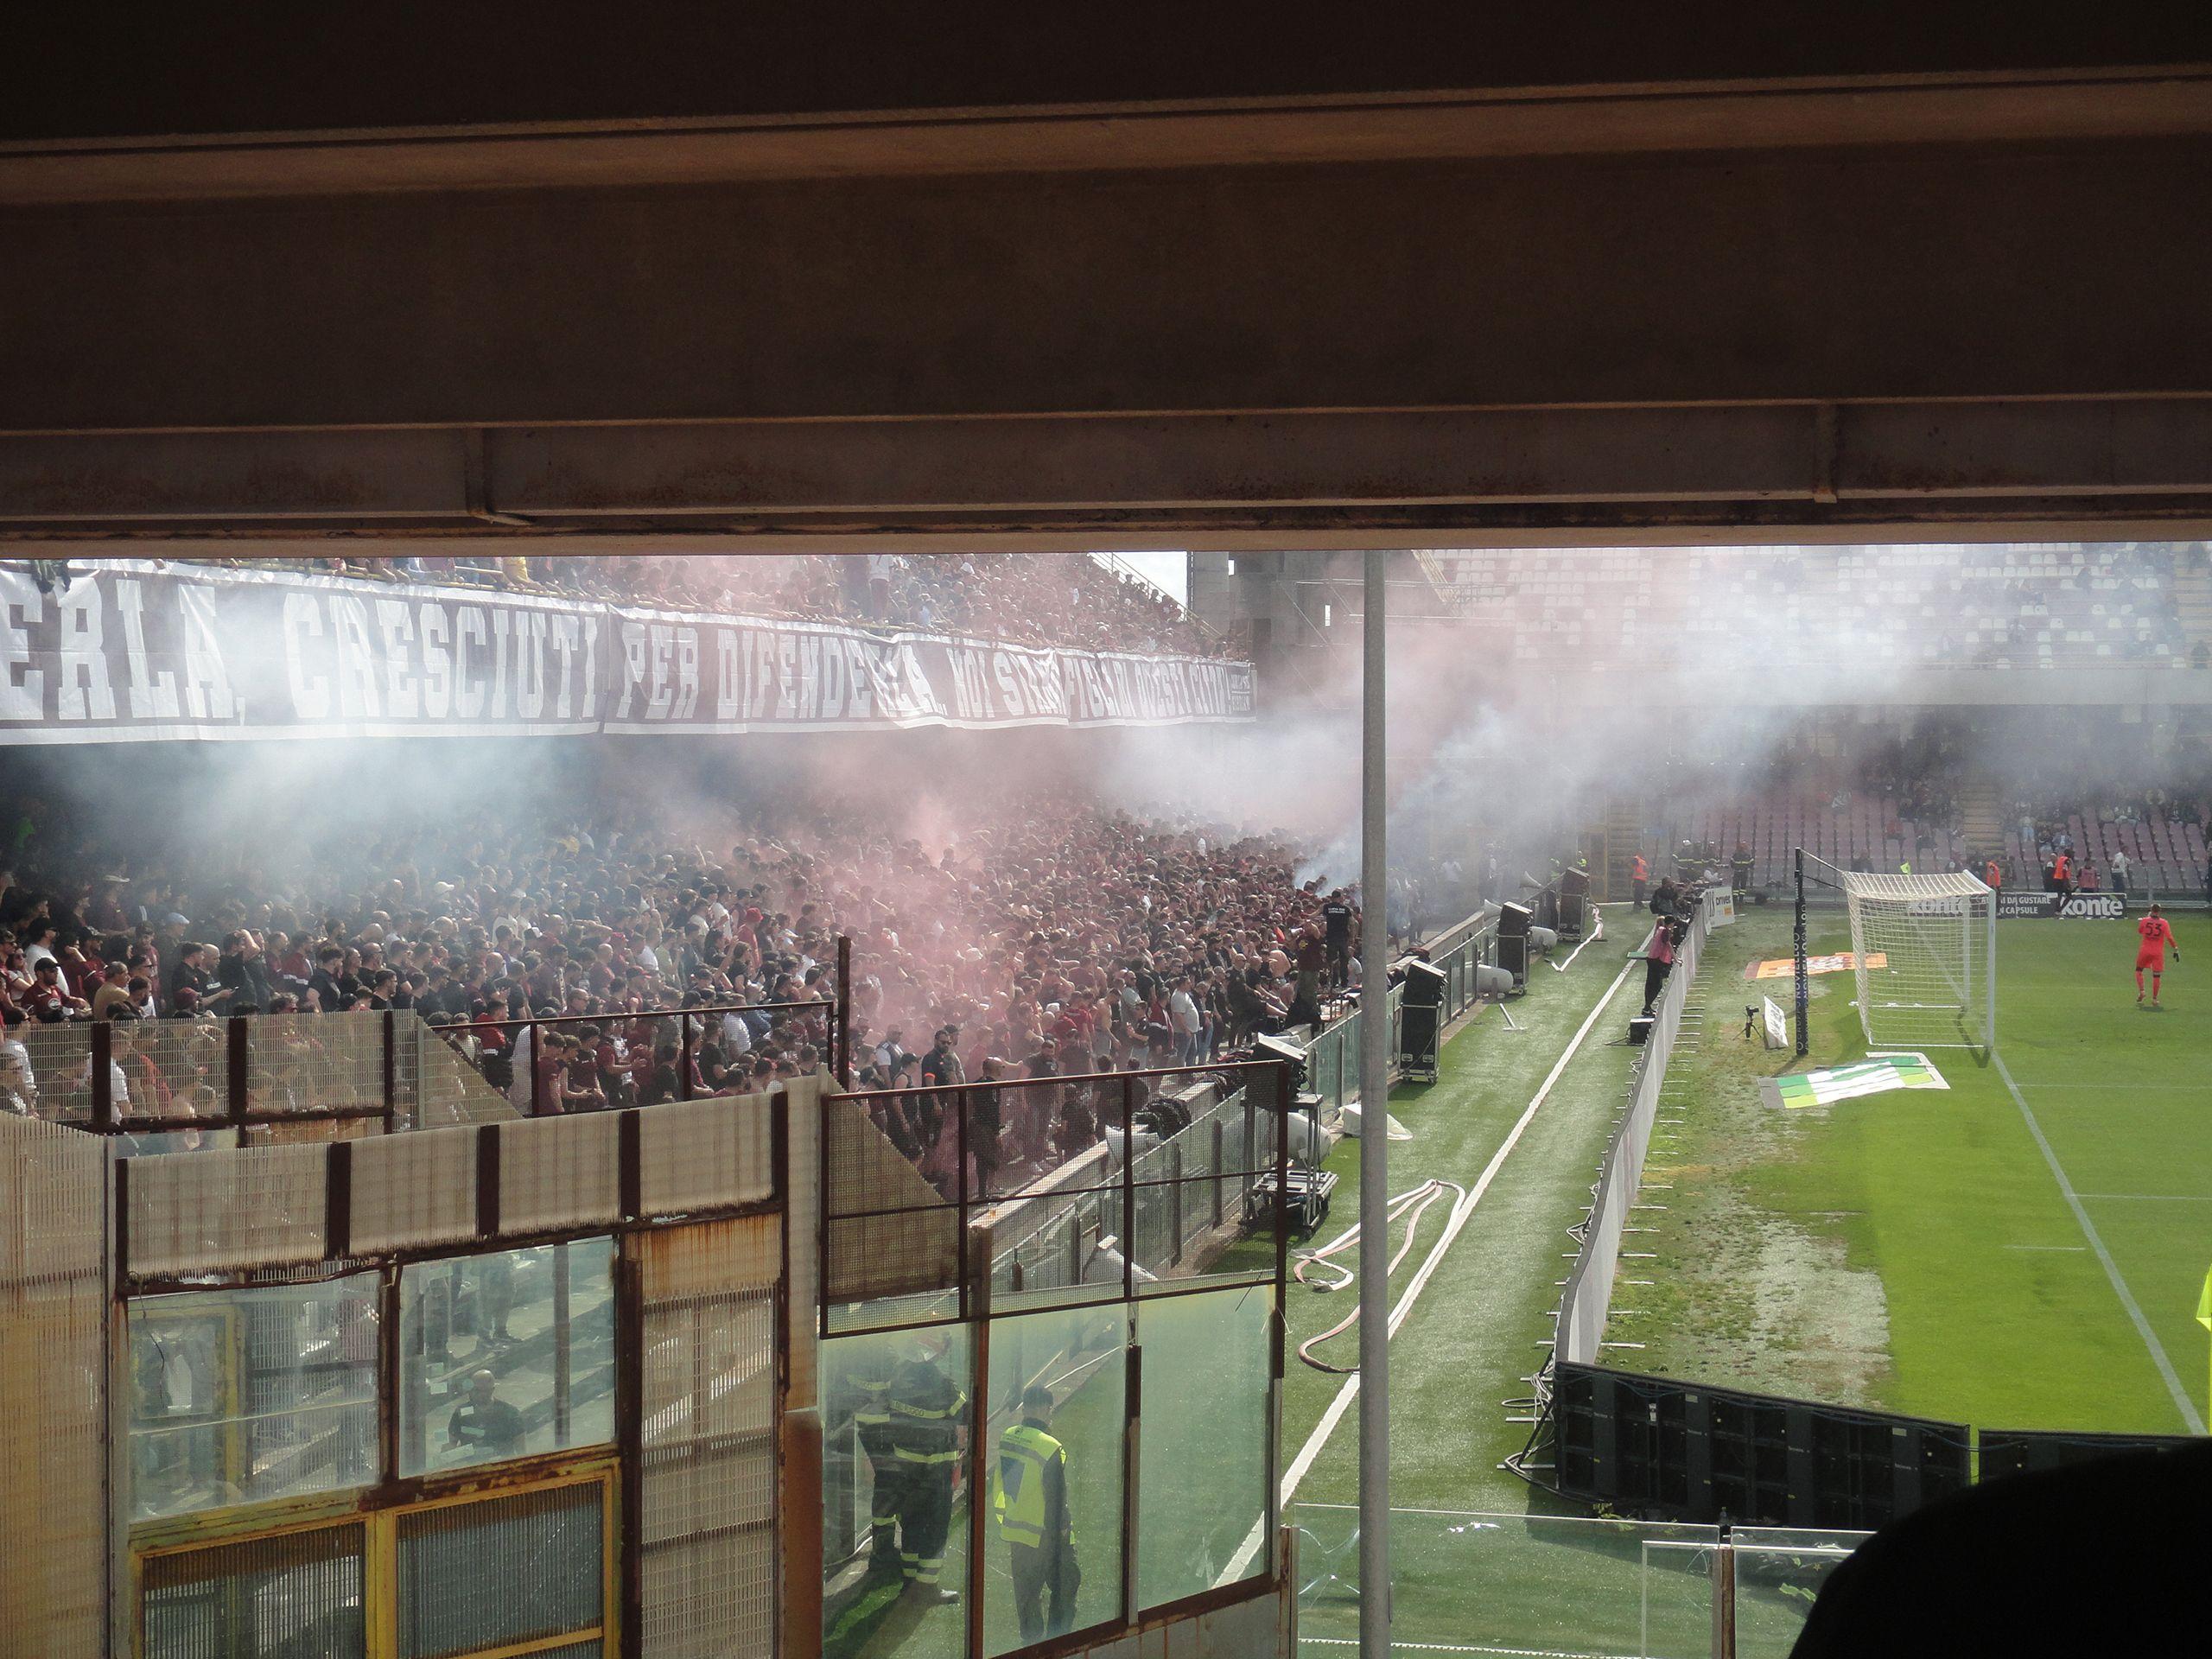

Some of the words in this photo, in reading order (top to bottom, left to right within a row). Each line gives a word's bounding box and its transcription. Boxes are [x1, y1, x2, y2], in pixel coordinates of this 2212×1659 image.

[283, 592, 598, 719] CRESCIUTI
[616, 624, 699, 719] PER
[946, 647, 995, 718] NOI
[2007, 896, 2018, 905] DA
[2019, 896, 2051, 905] GUSTARE
[2145, 922, 2162, 937] 53
